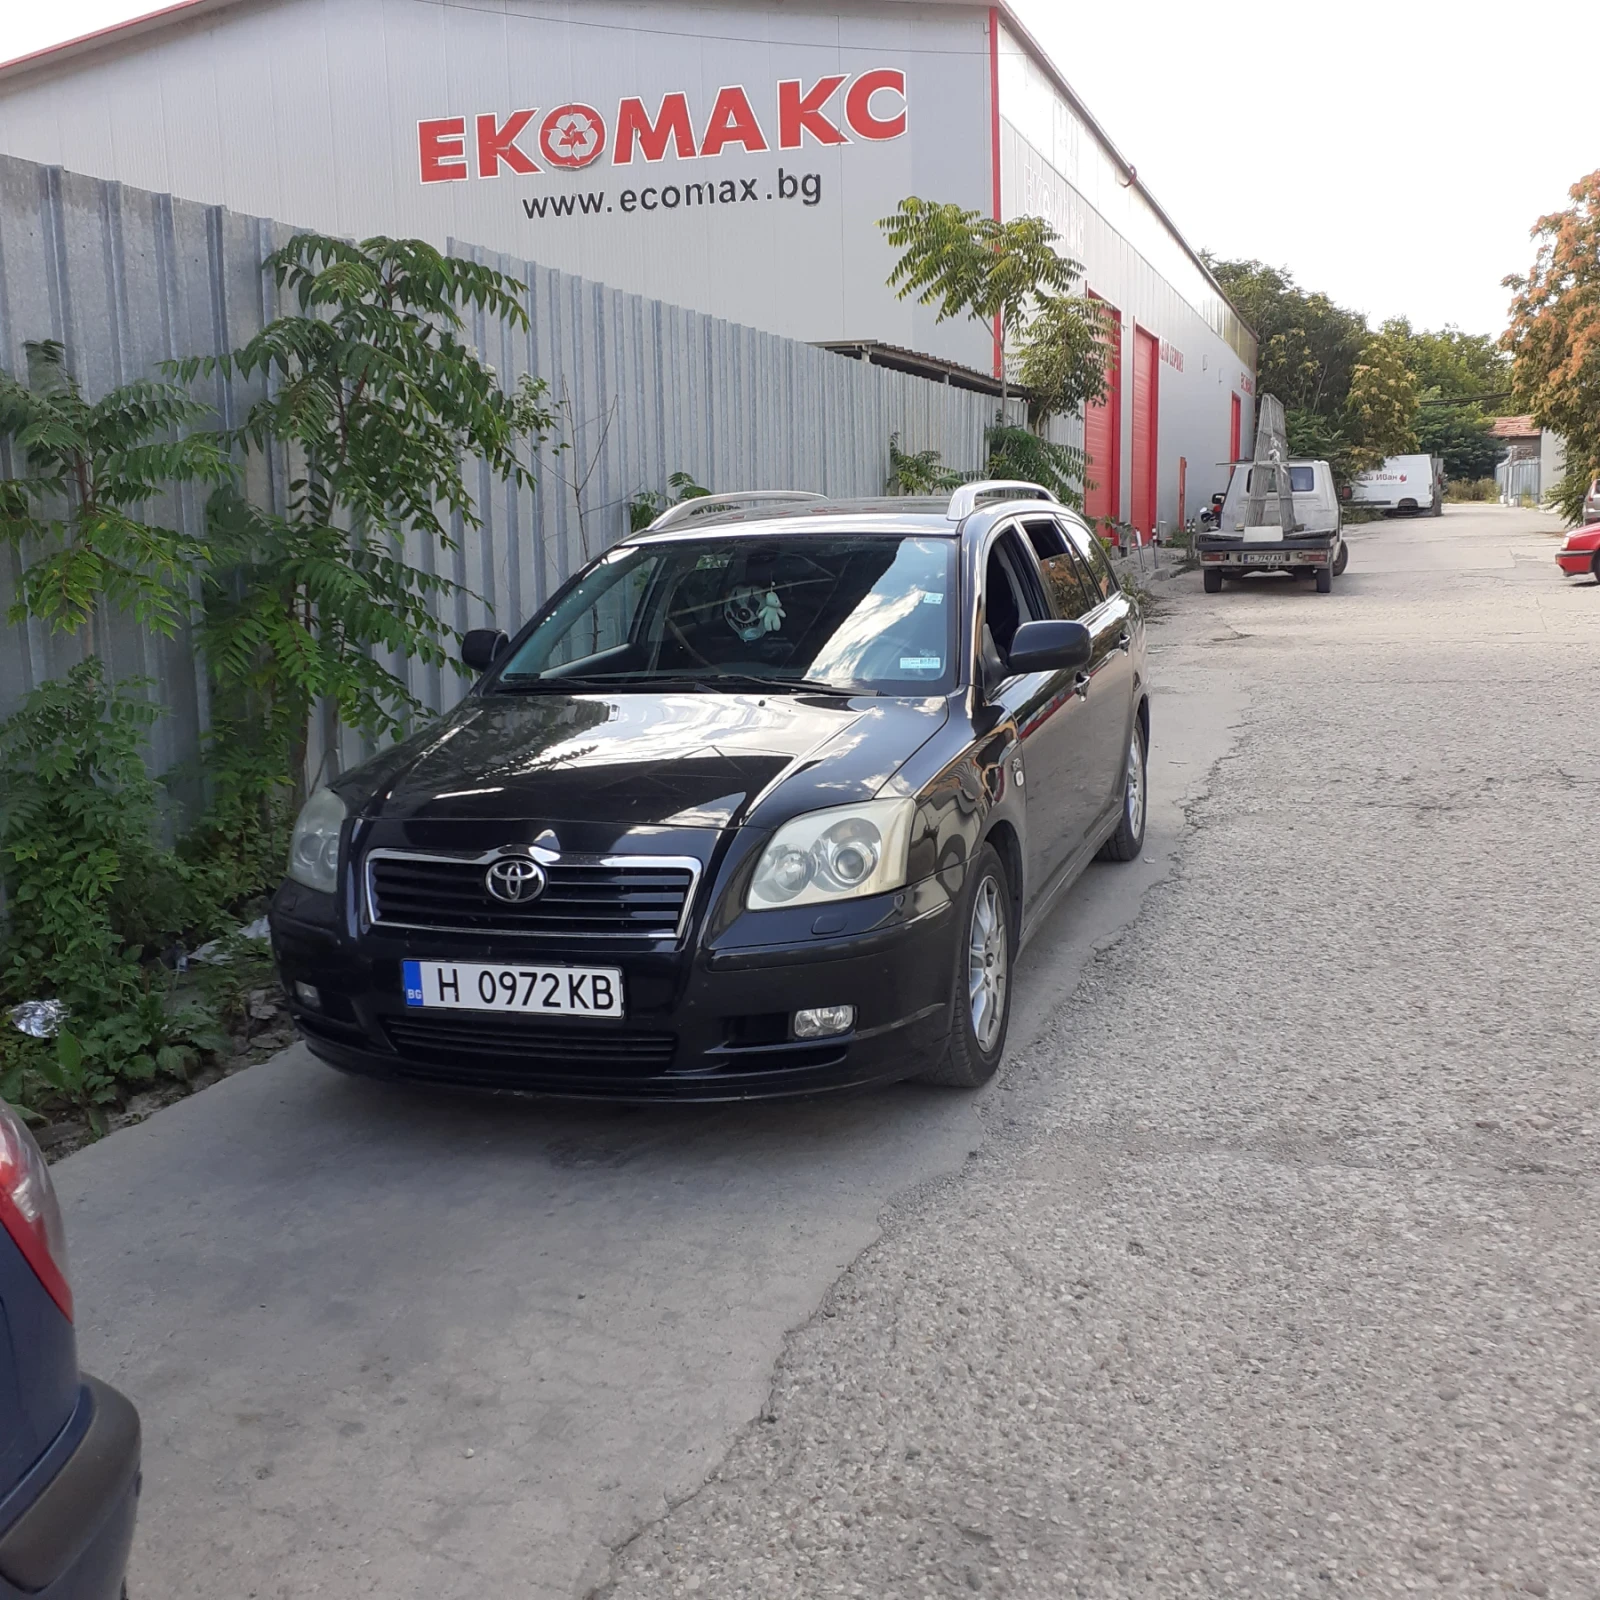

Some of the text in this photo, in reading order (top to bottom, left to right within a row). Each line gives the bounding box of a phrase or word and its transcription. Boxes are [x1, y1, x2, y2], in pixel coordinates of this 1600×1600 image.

[417, 68, 908, 185] ЕКОМАКС
[522, 167, 822, 220] www.ecomax.bg
[407, 988, 422, 999] BG
[437, 967, 460, 1003] H
